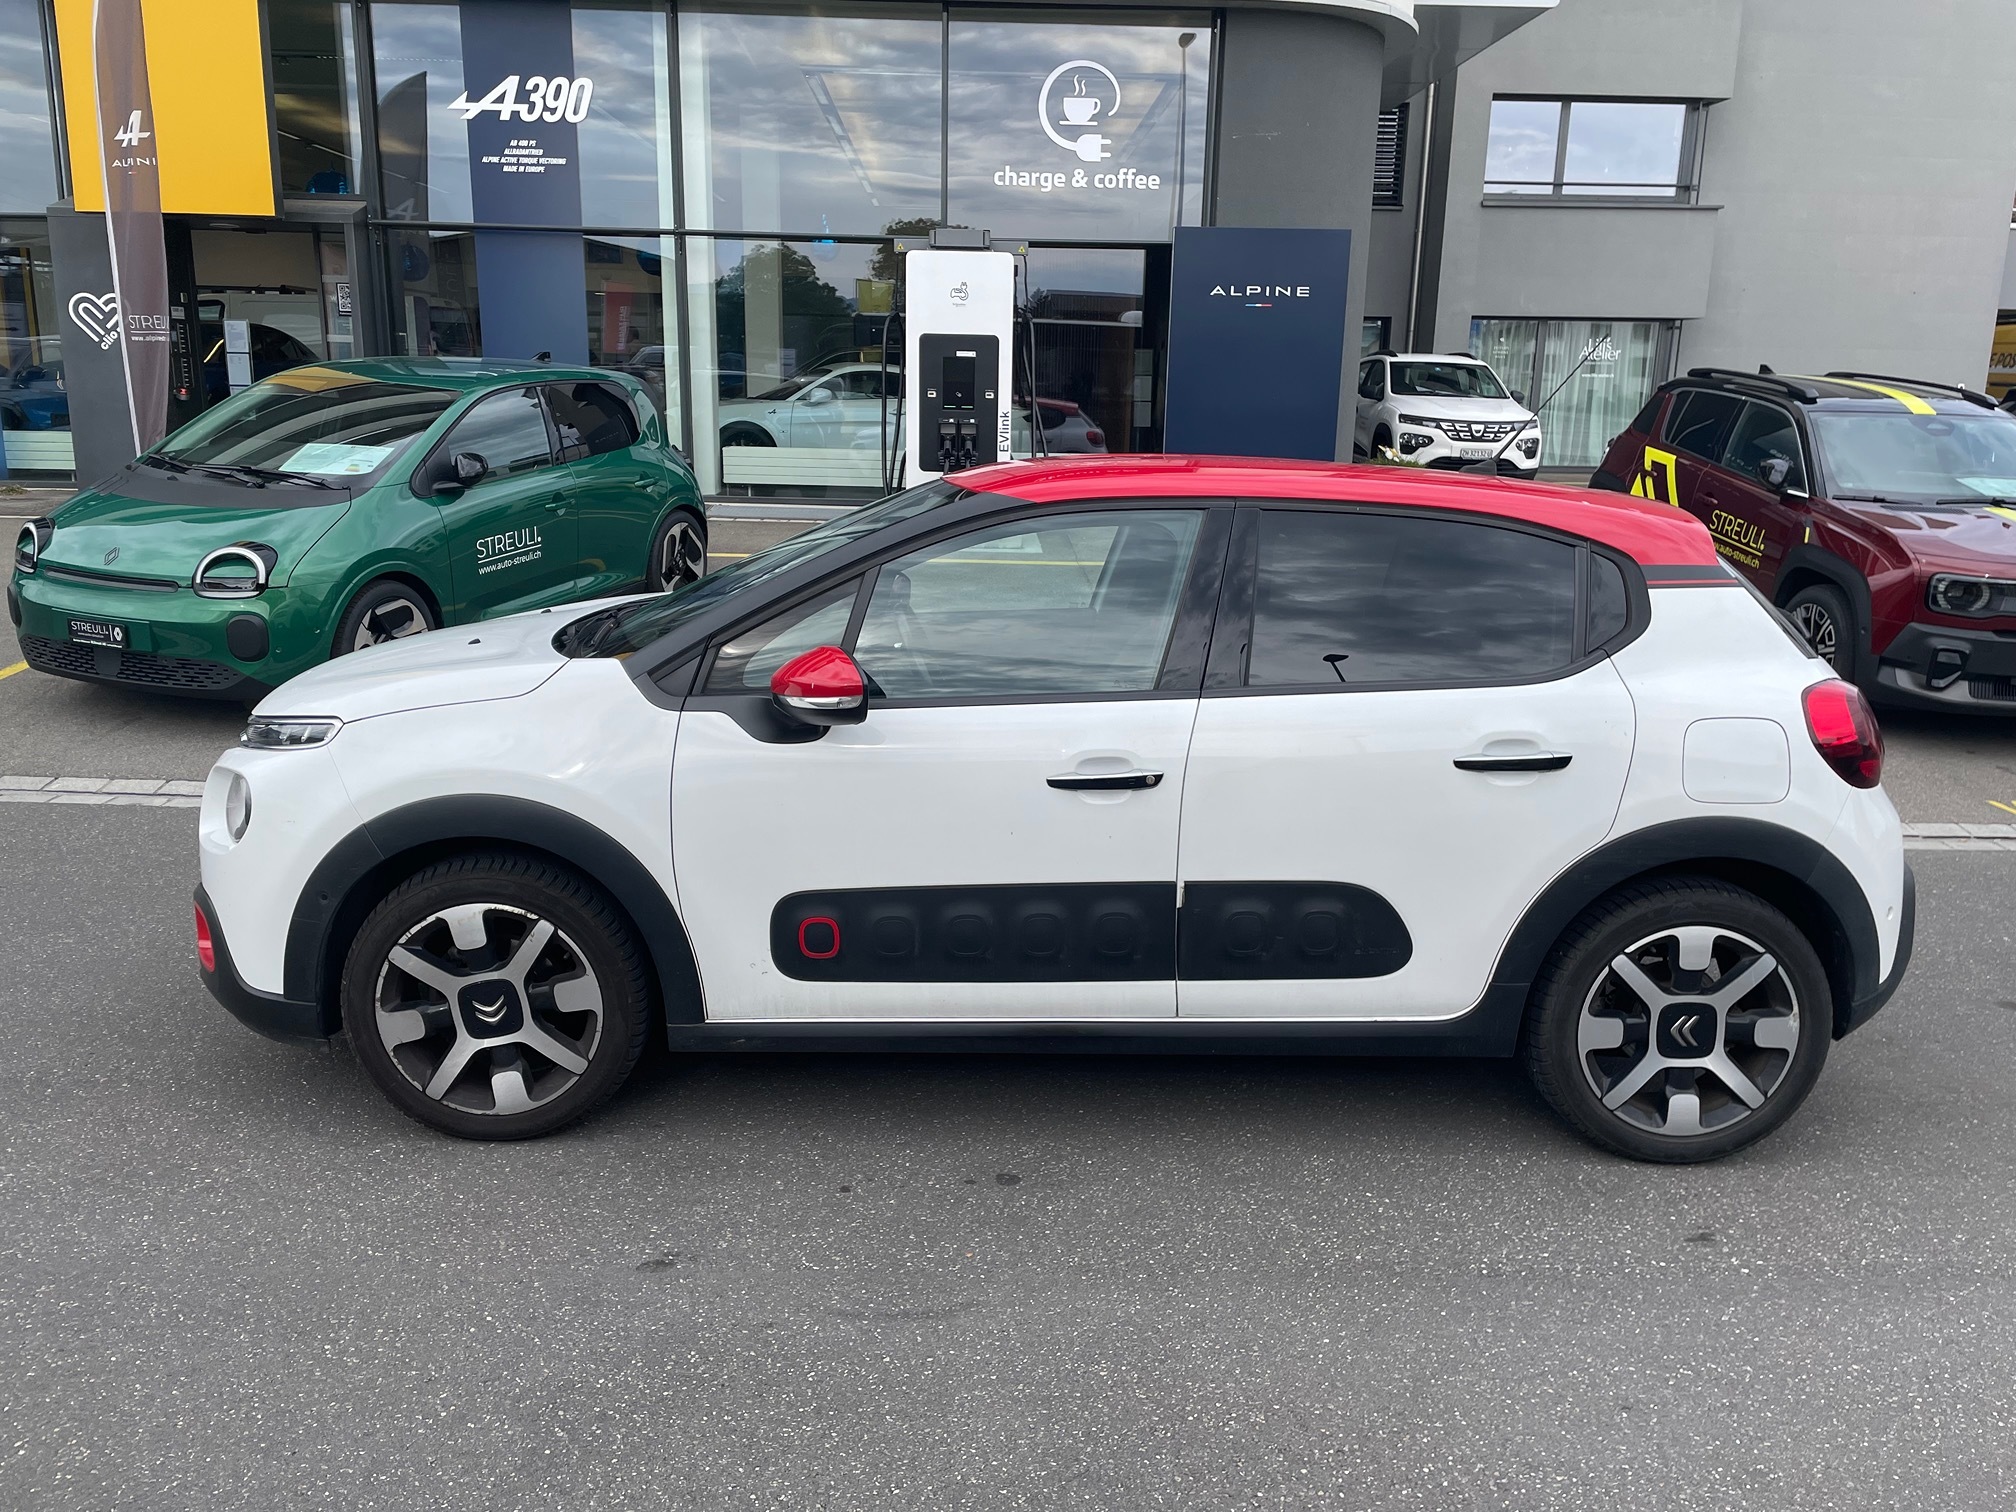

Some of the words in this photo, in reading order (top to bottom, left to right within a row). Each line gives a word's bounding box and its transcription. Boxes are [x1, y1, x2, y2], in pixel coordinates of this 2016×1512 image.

[446, 74, 594, 123] A390
[525, 165, 546, 173] EUROPE
[993, 165, 1066, 192] charge
[1071, 168, 1089, 188] &
[1093, 167, 1161, 189] coffee
[1209, 285, 1310, 297] ALPINE
[100, 330, 119, 350] clio
[998, 411, 1010, 453] EVlink
[476, 525, 542, 558] STREULI.
[1709, 509, 1766, 551] STREULI.
[478, 550, 542, 575] www.auto-streuli.ch
